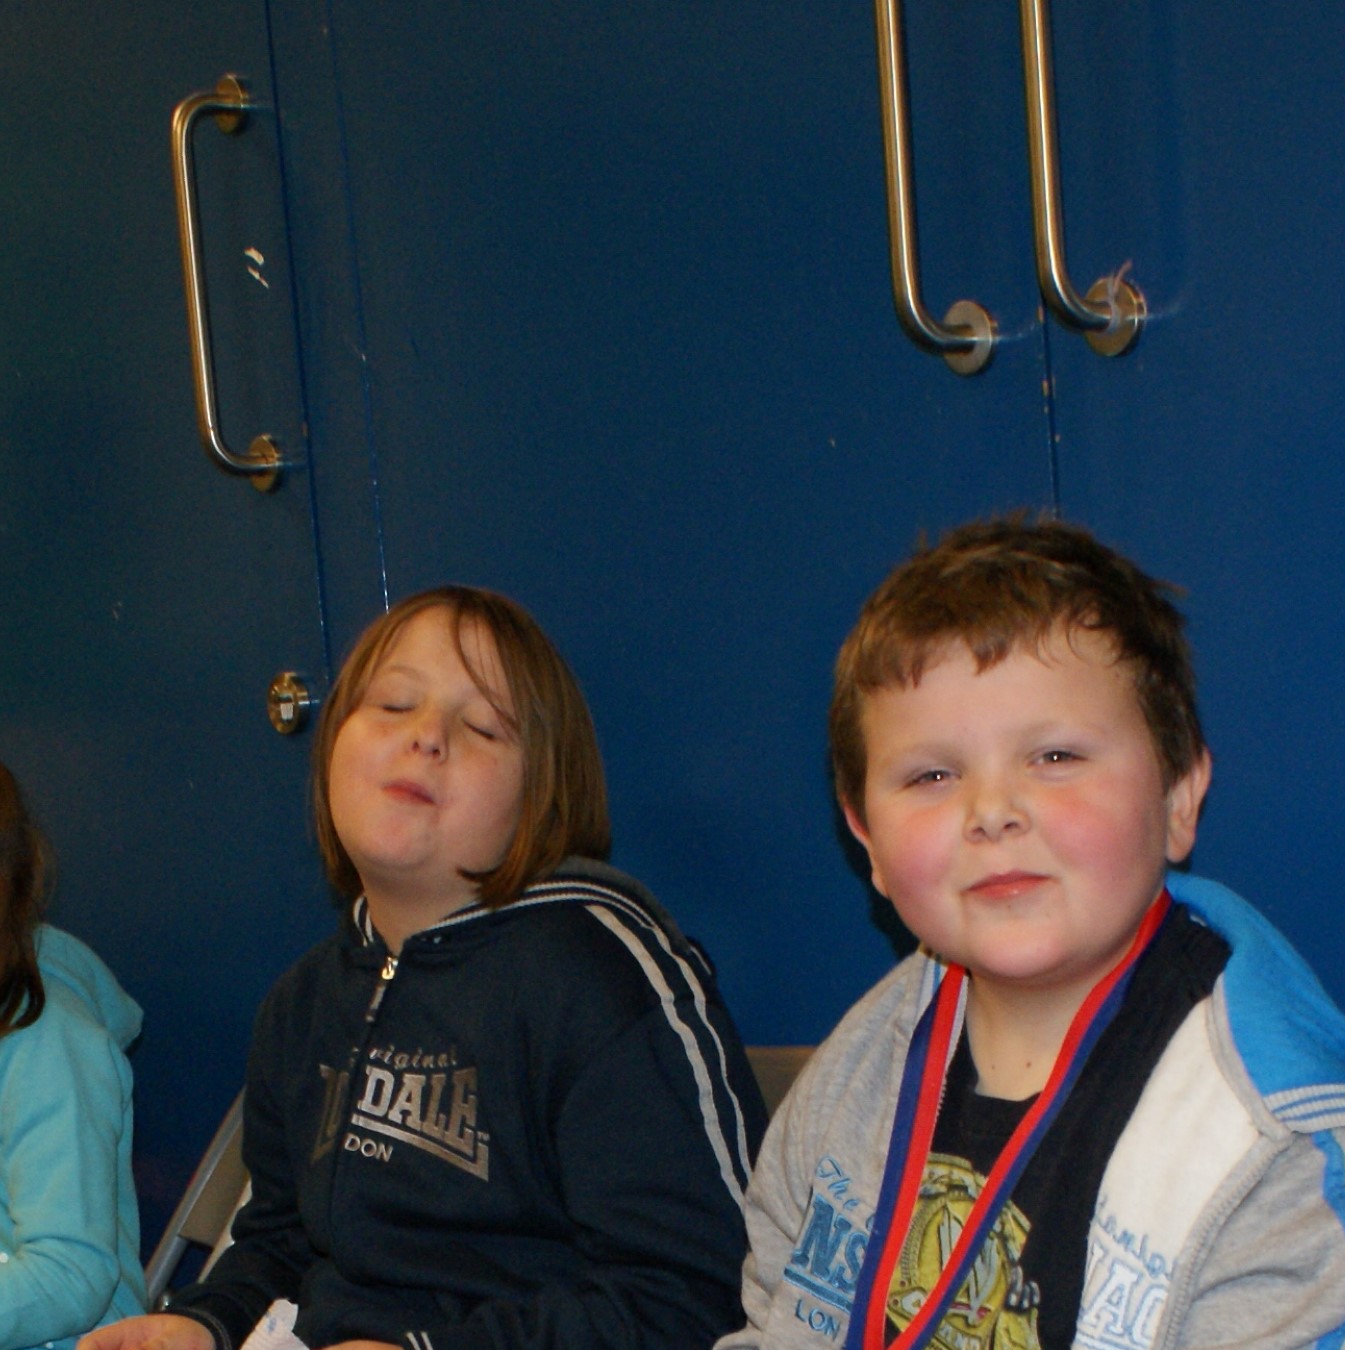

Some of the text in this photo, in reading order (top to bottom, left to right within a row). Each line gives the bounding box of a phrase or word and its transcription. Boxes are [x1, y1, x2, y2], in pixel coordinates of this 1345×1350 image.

[368, 1044, 457, 1070] riginal
[344, 1132, 394, 1163] DON
[790, 1193, 871, 1294] NS
